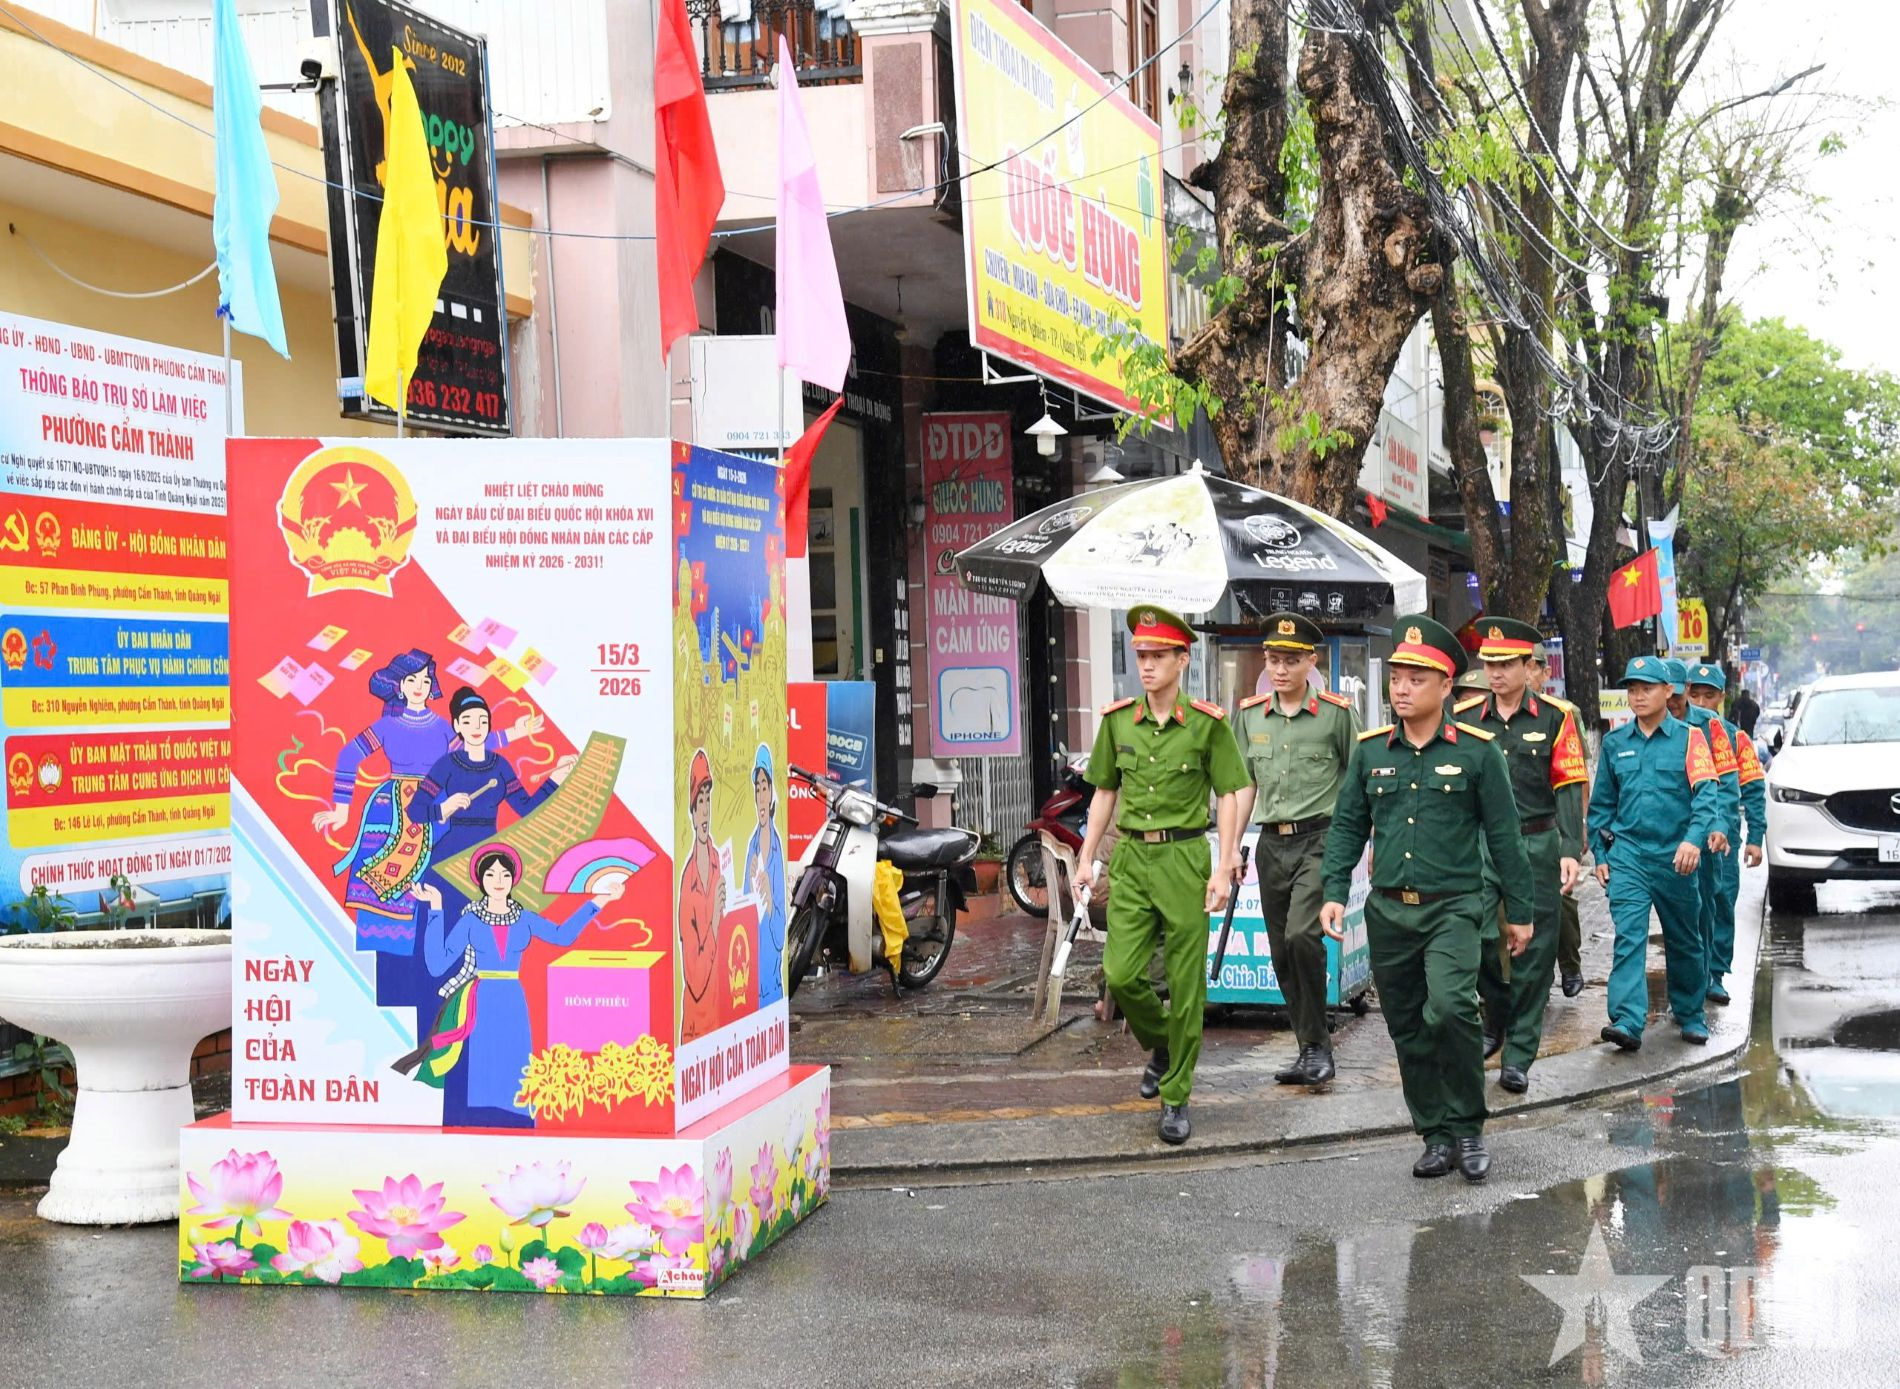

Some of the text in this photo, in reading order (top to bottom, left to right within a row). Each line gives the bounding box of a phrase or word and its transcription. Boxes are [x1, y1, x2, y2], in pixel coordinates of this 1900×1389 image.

[404, 25, 466, 76] Since 2012
[1020, 53, 1031, 92] DI
[1006, 150, 1142, 308] QUỐC HÙNG
[35, 335, 60, 355] HĐND
[71, 342, 95, 361] UBND
[105, 348, 150, 372] UBMTTQVN
[153, 357, 186, 379] PHƯỜNG
[20, 366, 207, 423] THÔNG BÁO TRỤ SỞ LÀM VIỆC
[441, 383, 470, 413] 232
[476, 391, 499, 417] 417
[41, 415, 194, 460] PHƯỜNG CẨM THÀNH
[727, 430, 791, 441] 0904 721 33
[928, 423, 1004, 461] ĐTDĐ
[485, 481, 604, 500] NHIỆT LIỆT CHÀO MỪNG
[933, 466, 1004, 515] QUỐC HÙNG
[435, 502, 653, 524] NGÀY BẦU CỬ ĐẠI BIỂU QUỐC HỘI KHÓA XVI
[72, 523, 226, 559] ĐẢNG ỦY HỘI ĐỒNG NHÂN DÂN
[436, 525, 653, 547] VÀ ĐẠI BIỂU HỘI ĐỒNG NHÂN DÂN CÁC CẤP
[932, 523, 982, 544] 0904 721
[486, 552, 604, 571] NHIỆM KỲ 2026 2031!
[1253, 553, 1338, 571] Legend
[40, 581, 49, 594] 57
[52, 582, 68, 596] Phan
[934, 583, 968, 615] MÀN
[1681, 591, 1702, 639] Tô
[117, 626, 191, 650] ỦY BAN NHÂN DÂN
[936, 618, 1010, 653] CẢM ỨNG
[67, 653, 229, 678] TRUNG TÂM PHỤC VỤ HÀNH CHÍNH CÔN
[597, 643, 640, 666] 15/3
[599, 677, 641, 696] 2026
[46, 699, 60, 713] 310
[951, 731, 1001, 740] IPHONE
[70, 736, 218, 765] ỦY BAN MẶT TRẬN TỔ QUỐC VIỆT
[72, 767, 216, 794] TRUNG TÂM CUNG ỨNG DỊCH VỤ
[68, 815, 81, 829] 146
[31, 861, 64, 886] CHÍNH
[67, 856, 94, 880] THỨC
[126, 852, 151, 878] ĐỘNG
[155, 846, 167, 870] TỪ
[169, 846, 192, 869] NGÀY
[194, 846, 231, 867] 01/7/202
[245, 954, 315, 982] NGÀY
[244, 994, 291, 1026] HỘI
[245, 1032, 296, 1061] CỦA
[681, 1017, 785, 1106] NGÀY HỘI CỦA TOÀN DÂN
[244, 1073, 379, 1102] TOÀN DÂN
